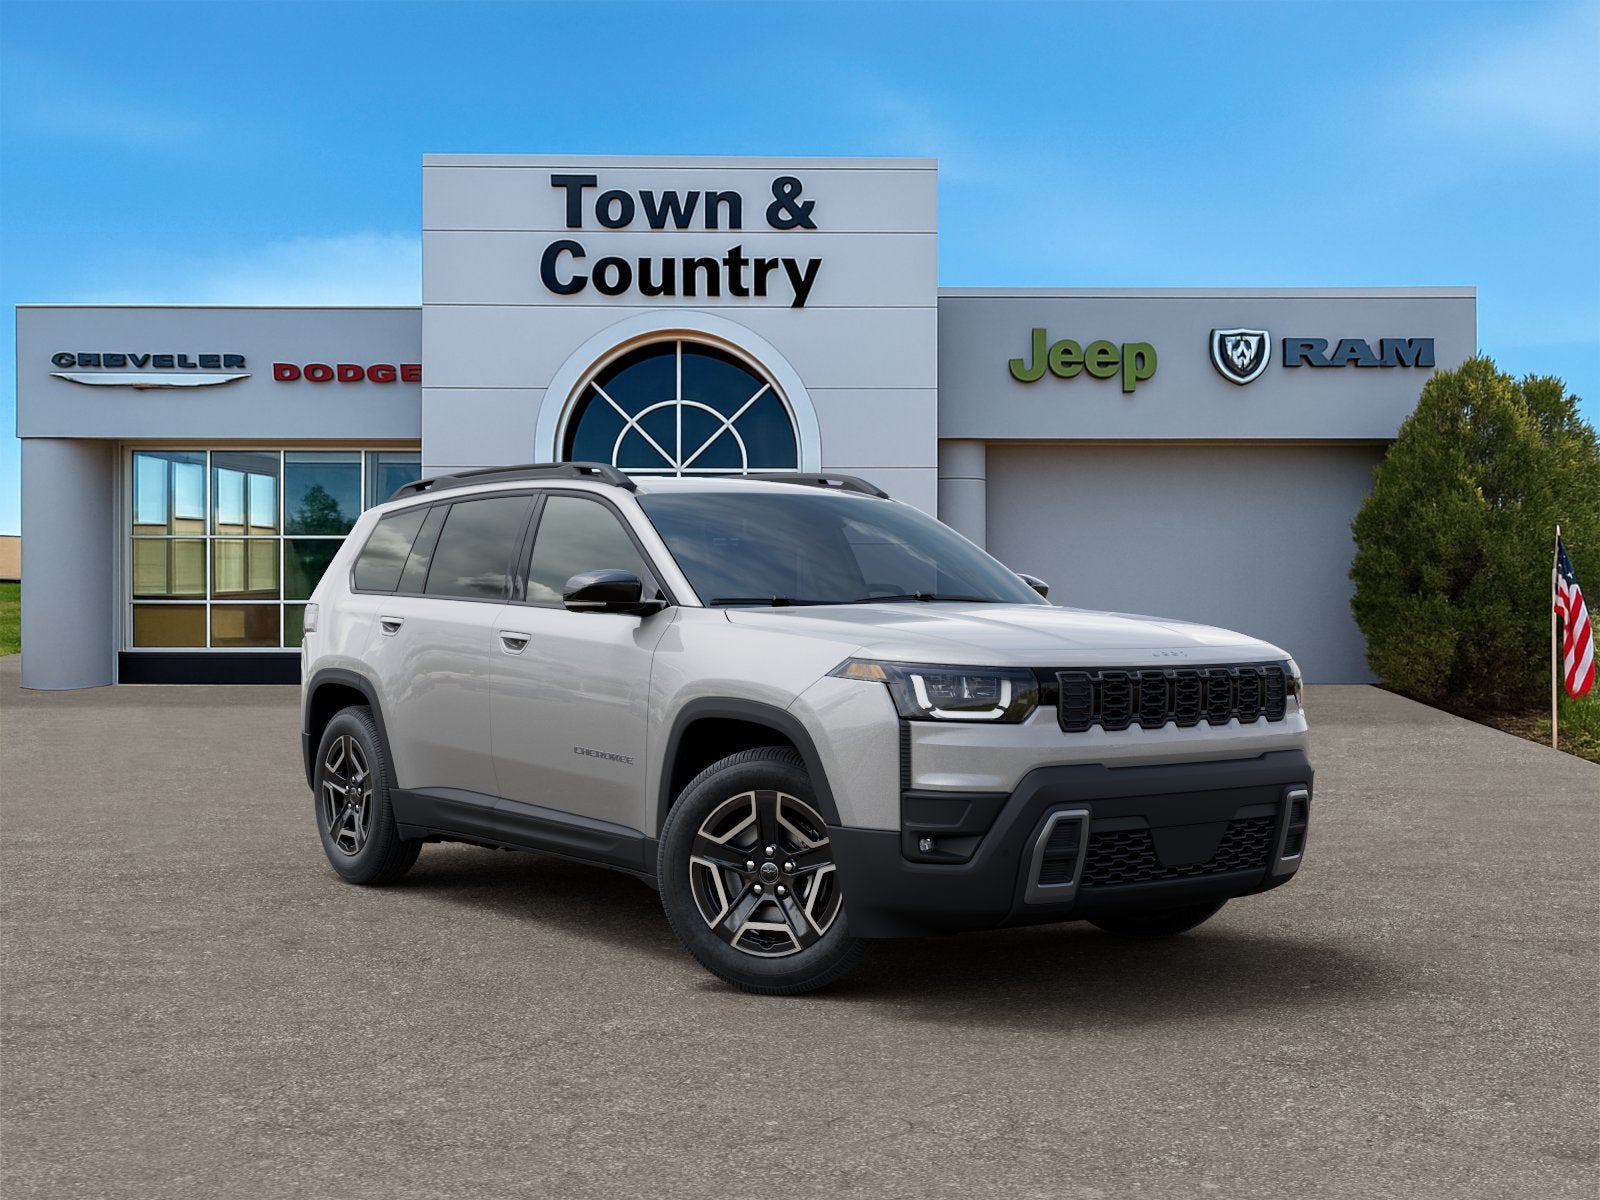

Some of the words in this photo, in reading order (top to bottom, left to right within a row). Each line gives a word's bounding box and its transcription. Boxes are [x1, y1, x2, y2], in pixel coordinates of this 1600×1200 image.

[550, 174, 742, 229] Town
[766, 175, 818, 230] &
[540, 239, 822, 308] Country
[273, 363, 422, 383] DODGE
[1009, 328, 1158, 393] Jeep
[1283, 338, 1436, 368] RAM
